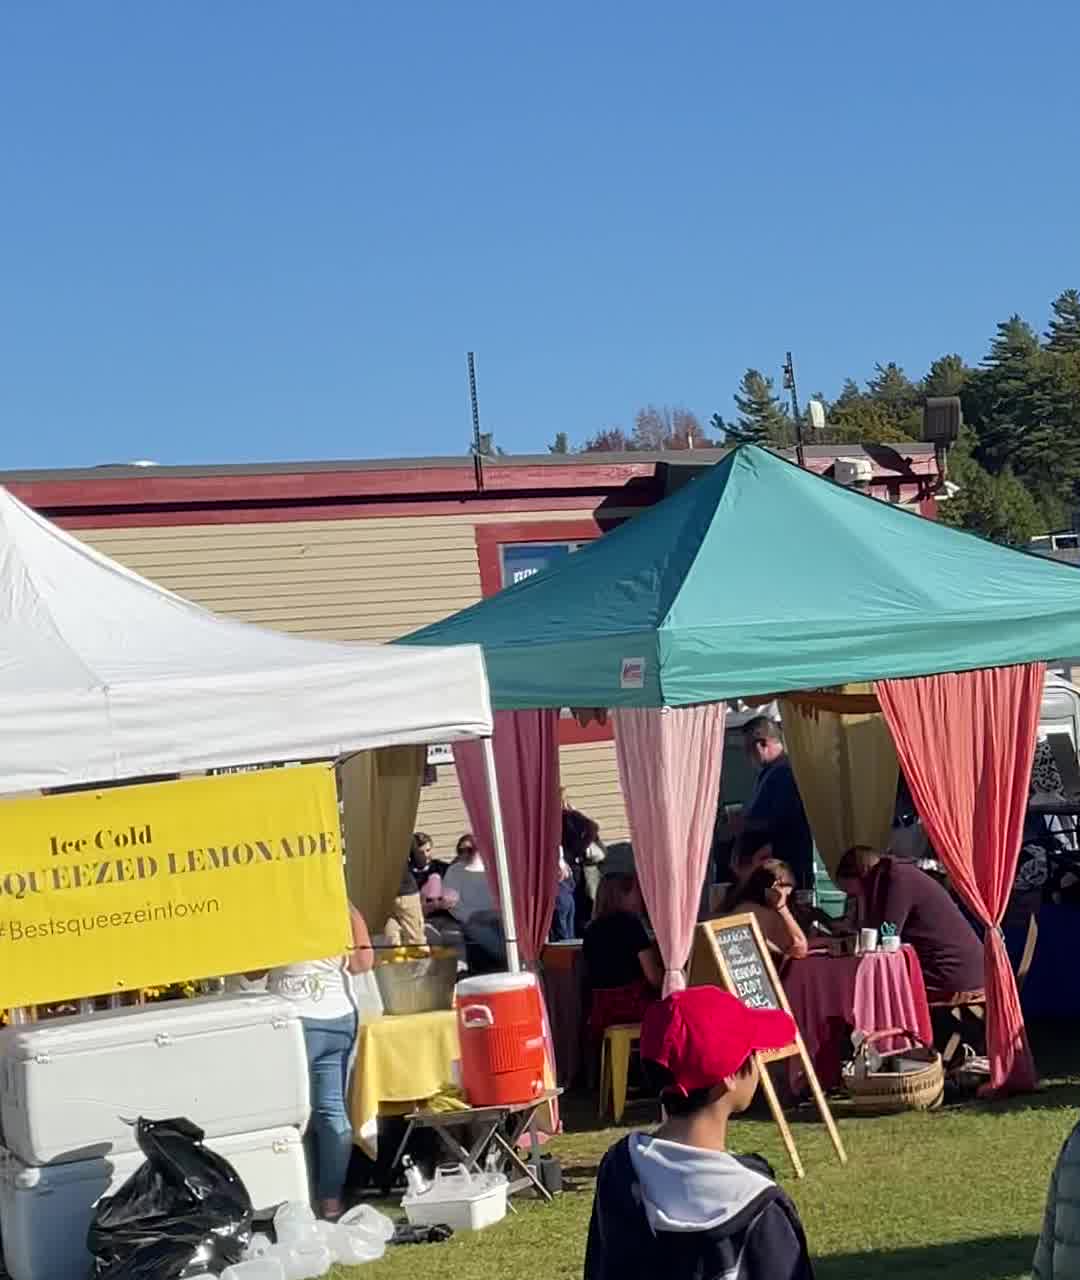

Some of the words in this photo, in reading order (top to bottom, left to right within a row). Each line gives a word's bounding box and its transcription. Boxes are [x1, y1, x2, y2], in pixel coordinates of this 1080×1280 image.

[50, 836, 87, 856] Ice
[94, 824, 152, 850] Cold
[0, 855, 158, 899] QUEEZED
[167, 832, 337, 875] LEMONADE
